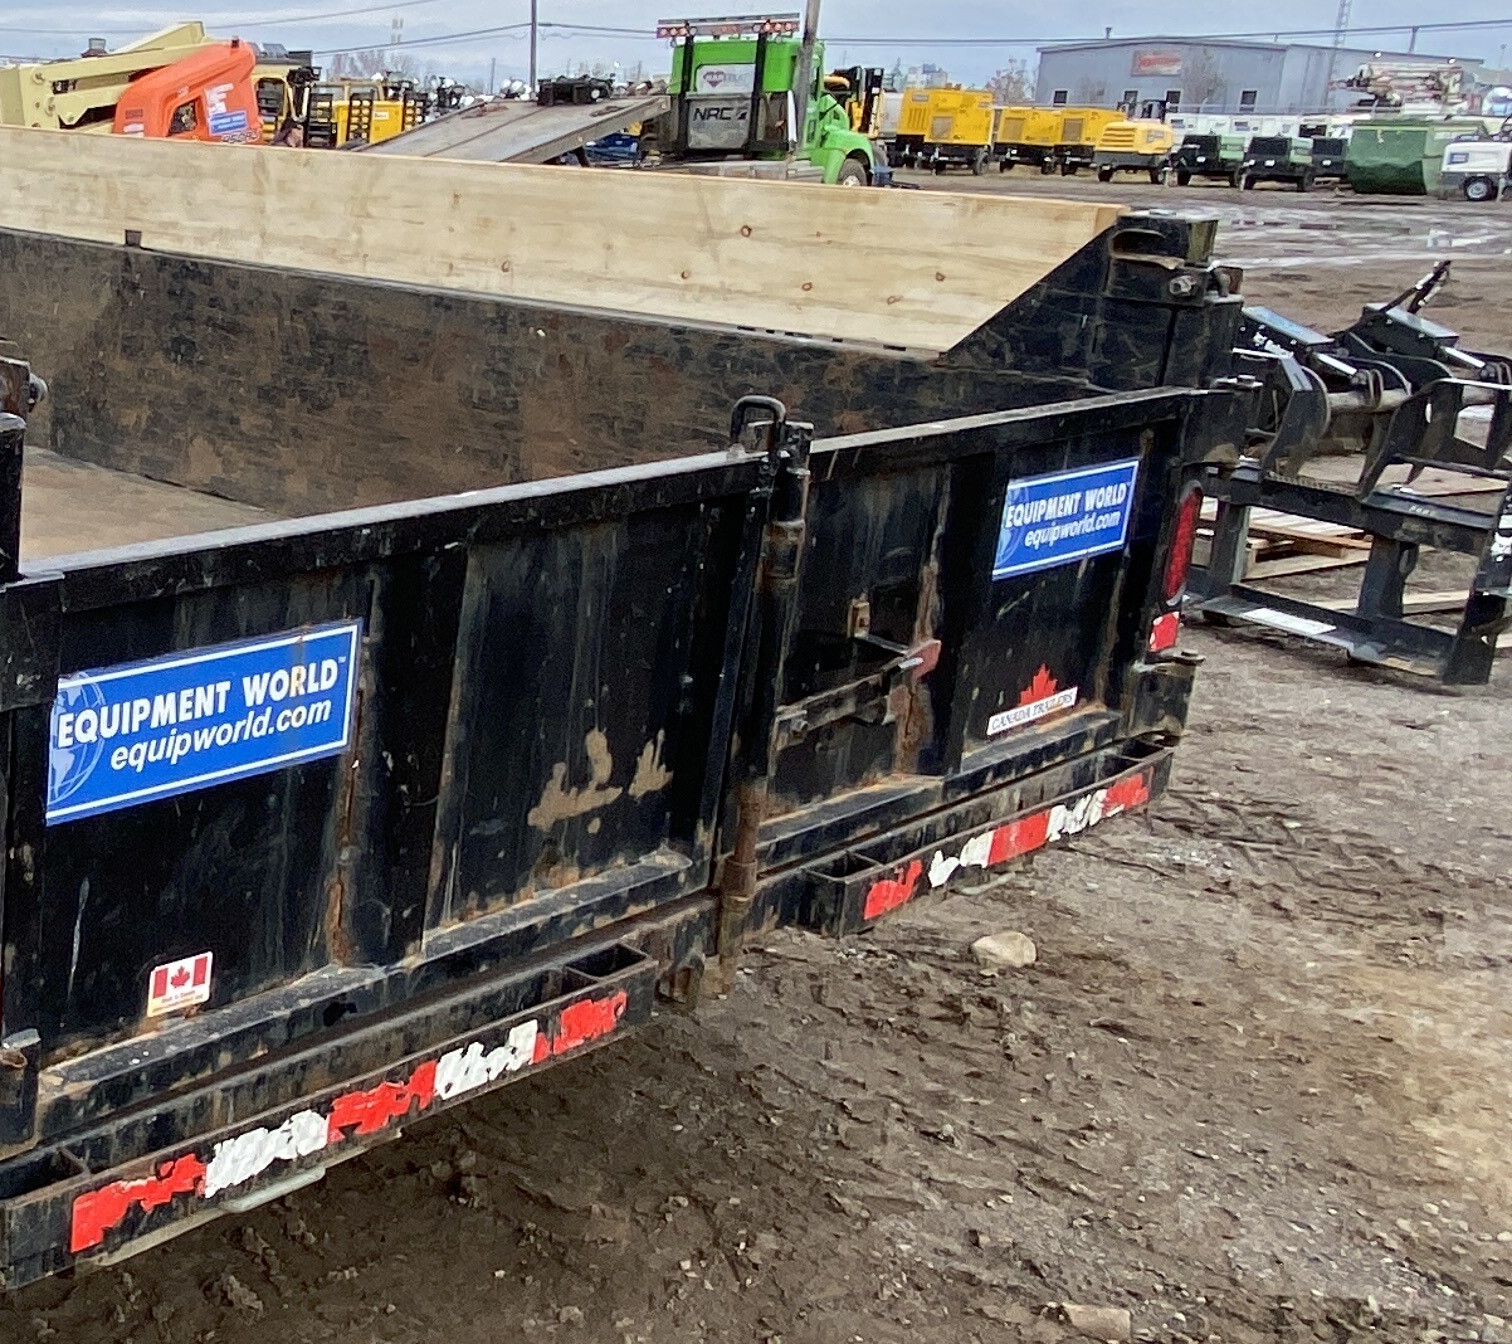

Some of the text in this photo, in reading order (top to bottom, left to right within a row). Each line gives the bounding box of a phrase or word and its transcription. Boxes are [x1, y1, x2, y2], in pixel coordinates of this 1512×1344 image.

[693, 107, 734, 121] NRC
[1005, 483, 1127, 528] EQUIPMENT WORLD
[1024, 511, 1121, 550] equipworld.com
[57, 658, 339, 747] EQUIPMENT WORLD
[110, 699, 333, 773] equipworld.com
